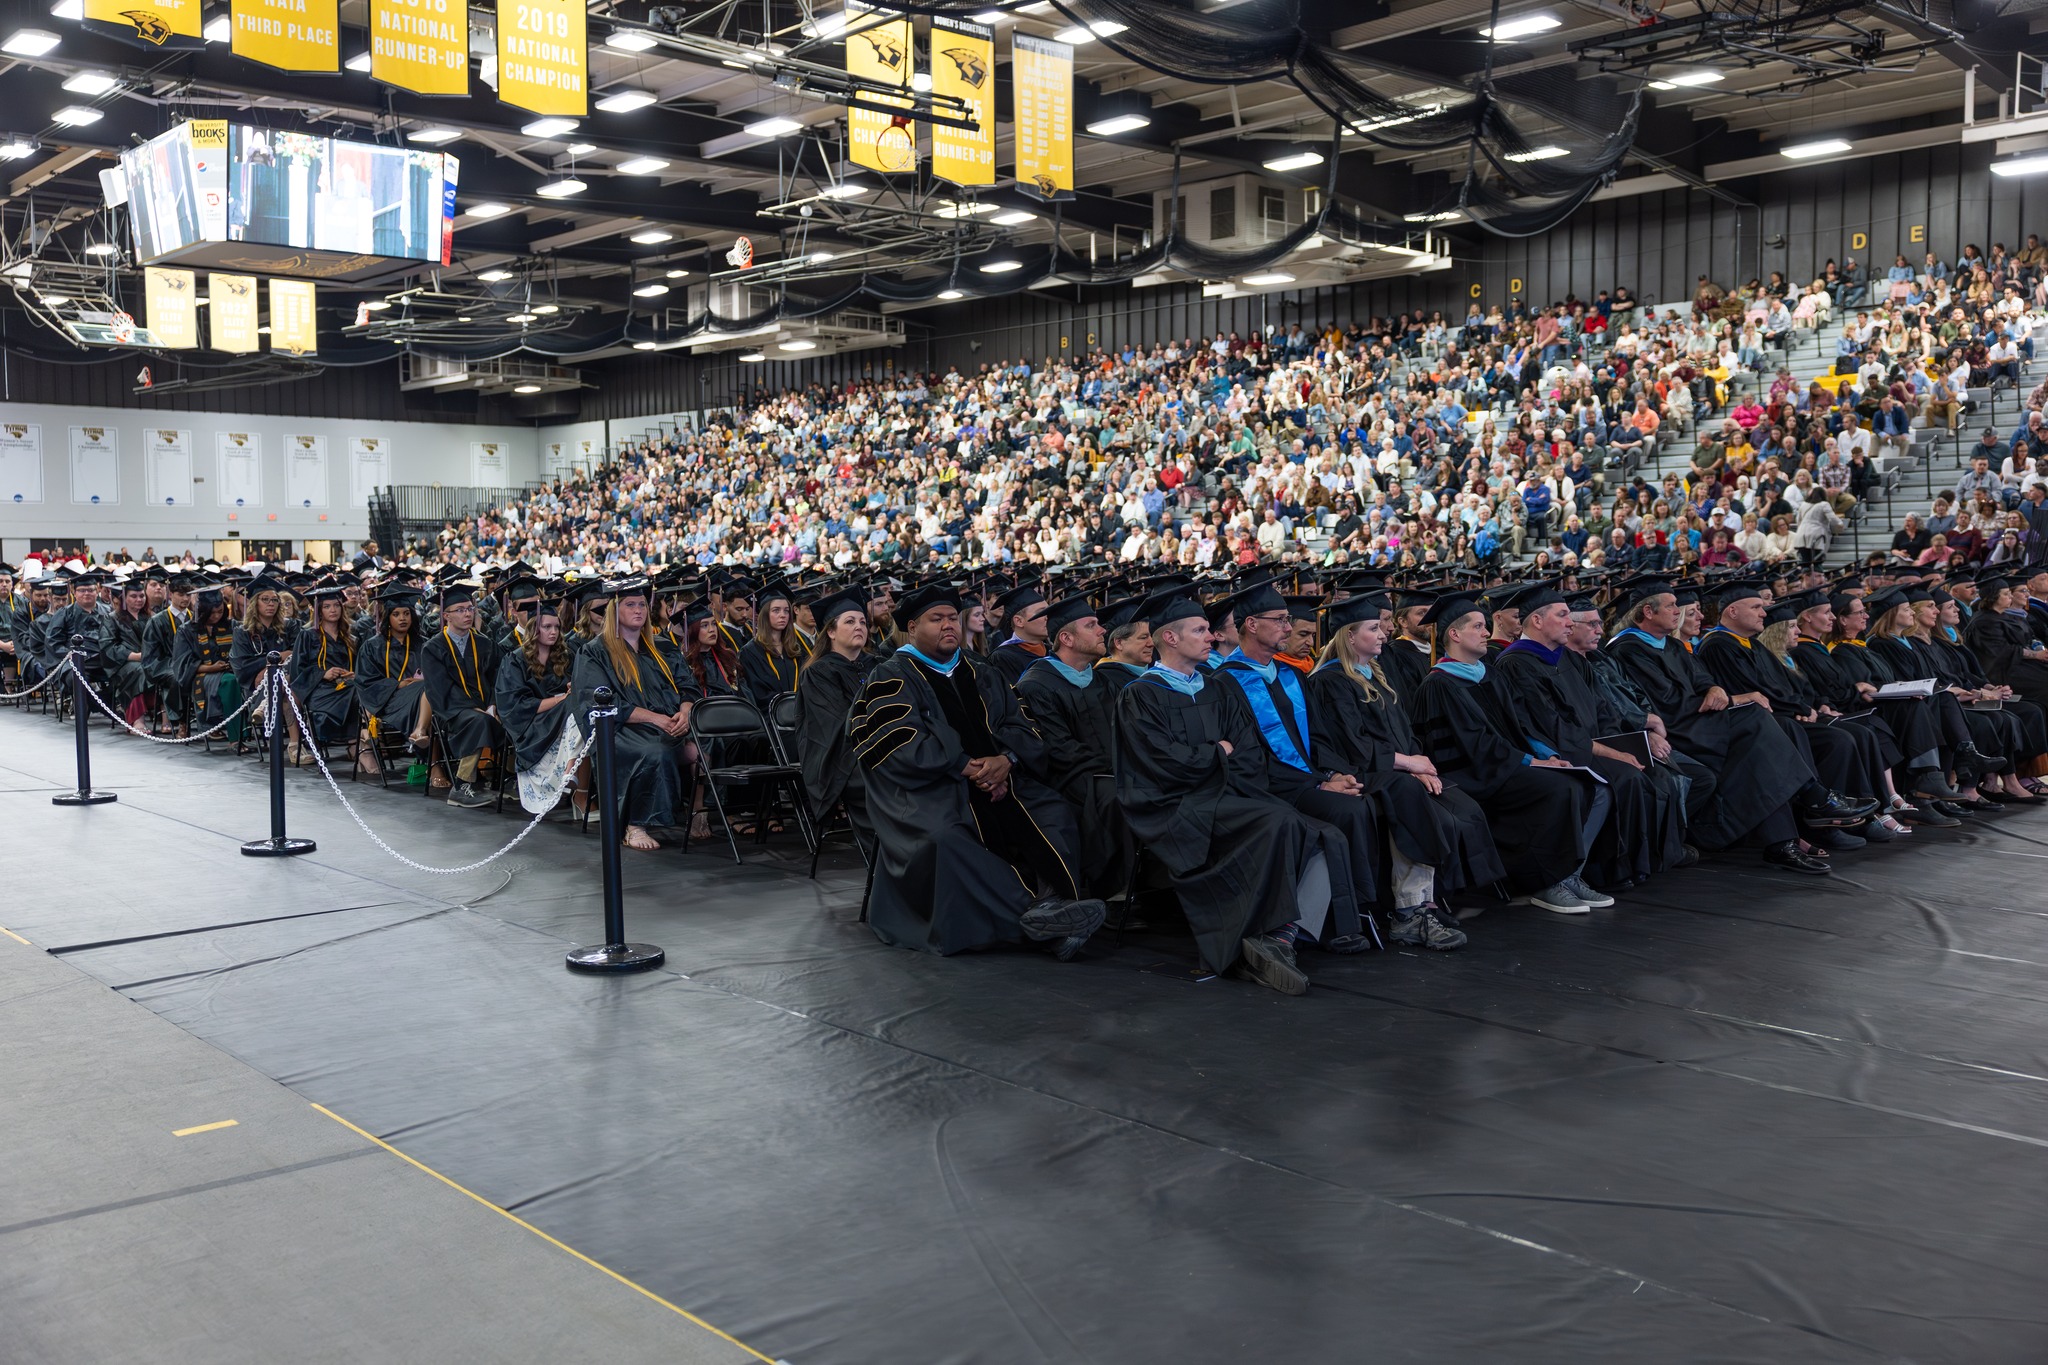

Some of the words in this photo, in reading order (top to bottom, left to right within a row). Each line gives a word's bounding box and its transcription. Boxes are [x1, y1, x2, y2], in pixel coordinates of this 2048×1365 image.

[237, 13, 282, 36] THIRD
[288, 22, 333, 46] PLACE
[380, 10, 459, 43] NATIONAL
[517, 4, 568, 38] 2019
[934, 15, 959, 29] WOMEN'S
[959, 21, 991, 36] BASKETBALL
[374, 36, 465, 70] RUNNER-UP
[507, 36, 579, 66] NATIONAL
[505, 62, 580, 92] CHAMPION
[948, 98, 982, 121] 195
[191, 123, 225, 143] books
[938, 125, 989, 143] NATIONAL
[934, 142, 992, 164] RUNNER-UP
[1853, 233, 1867, 250] D
[1911, 225, 1924, 243] E
[1470, 283, 1481, 298] C
[1511, 278, 1522, 293] D
[1061, 336, 1069, 348] B
[1087, 333, 1095, 345] C
